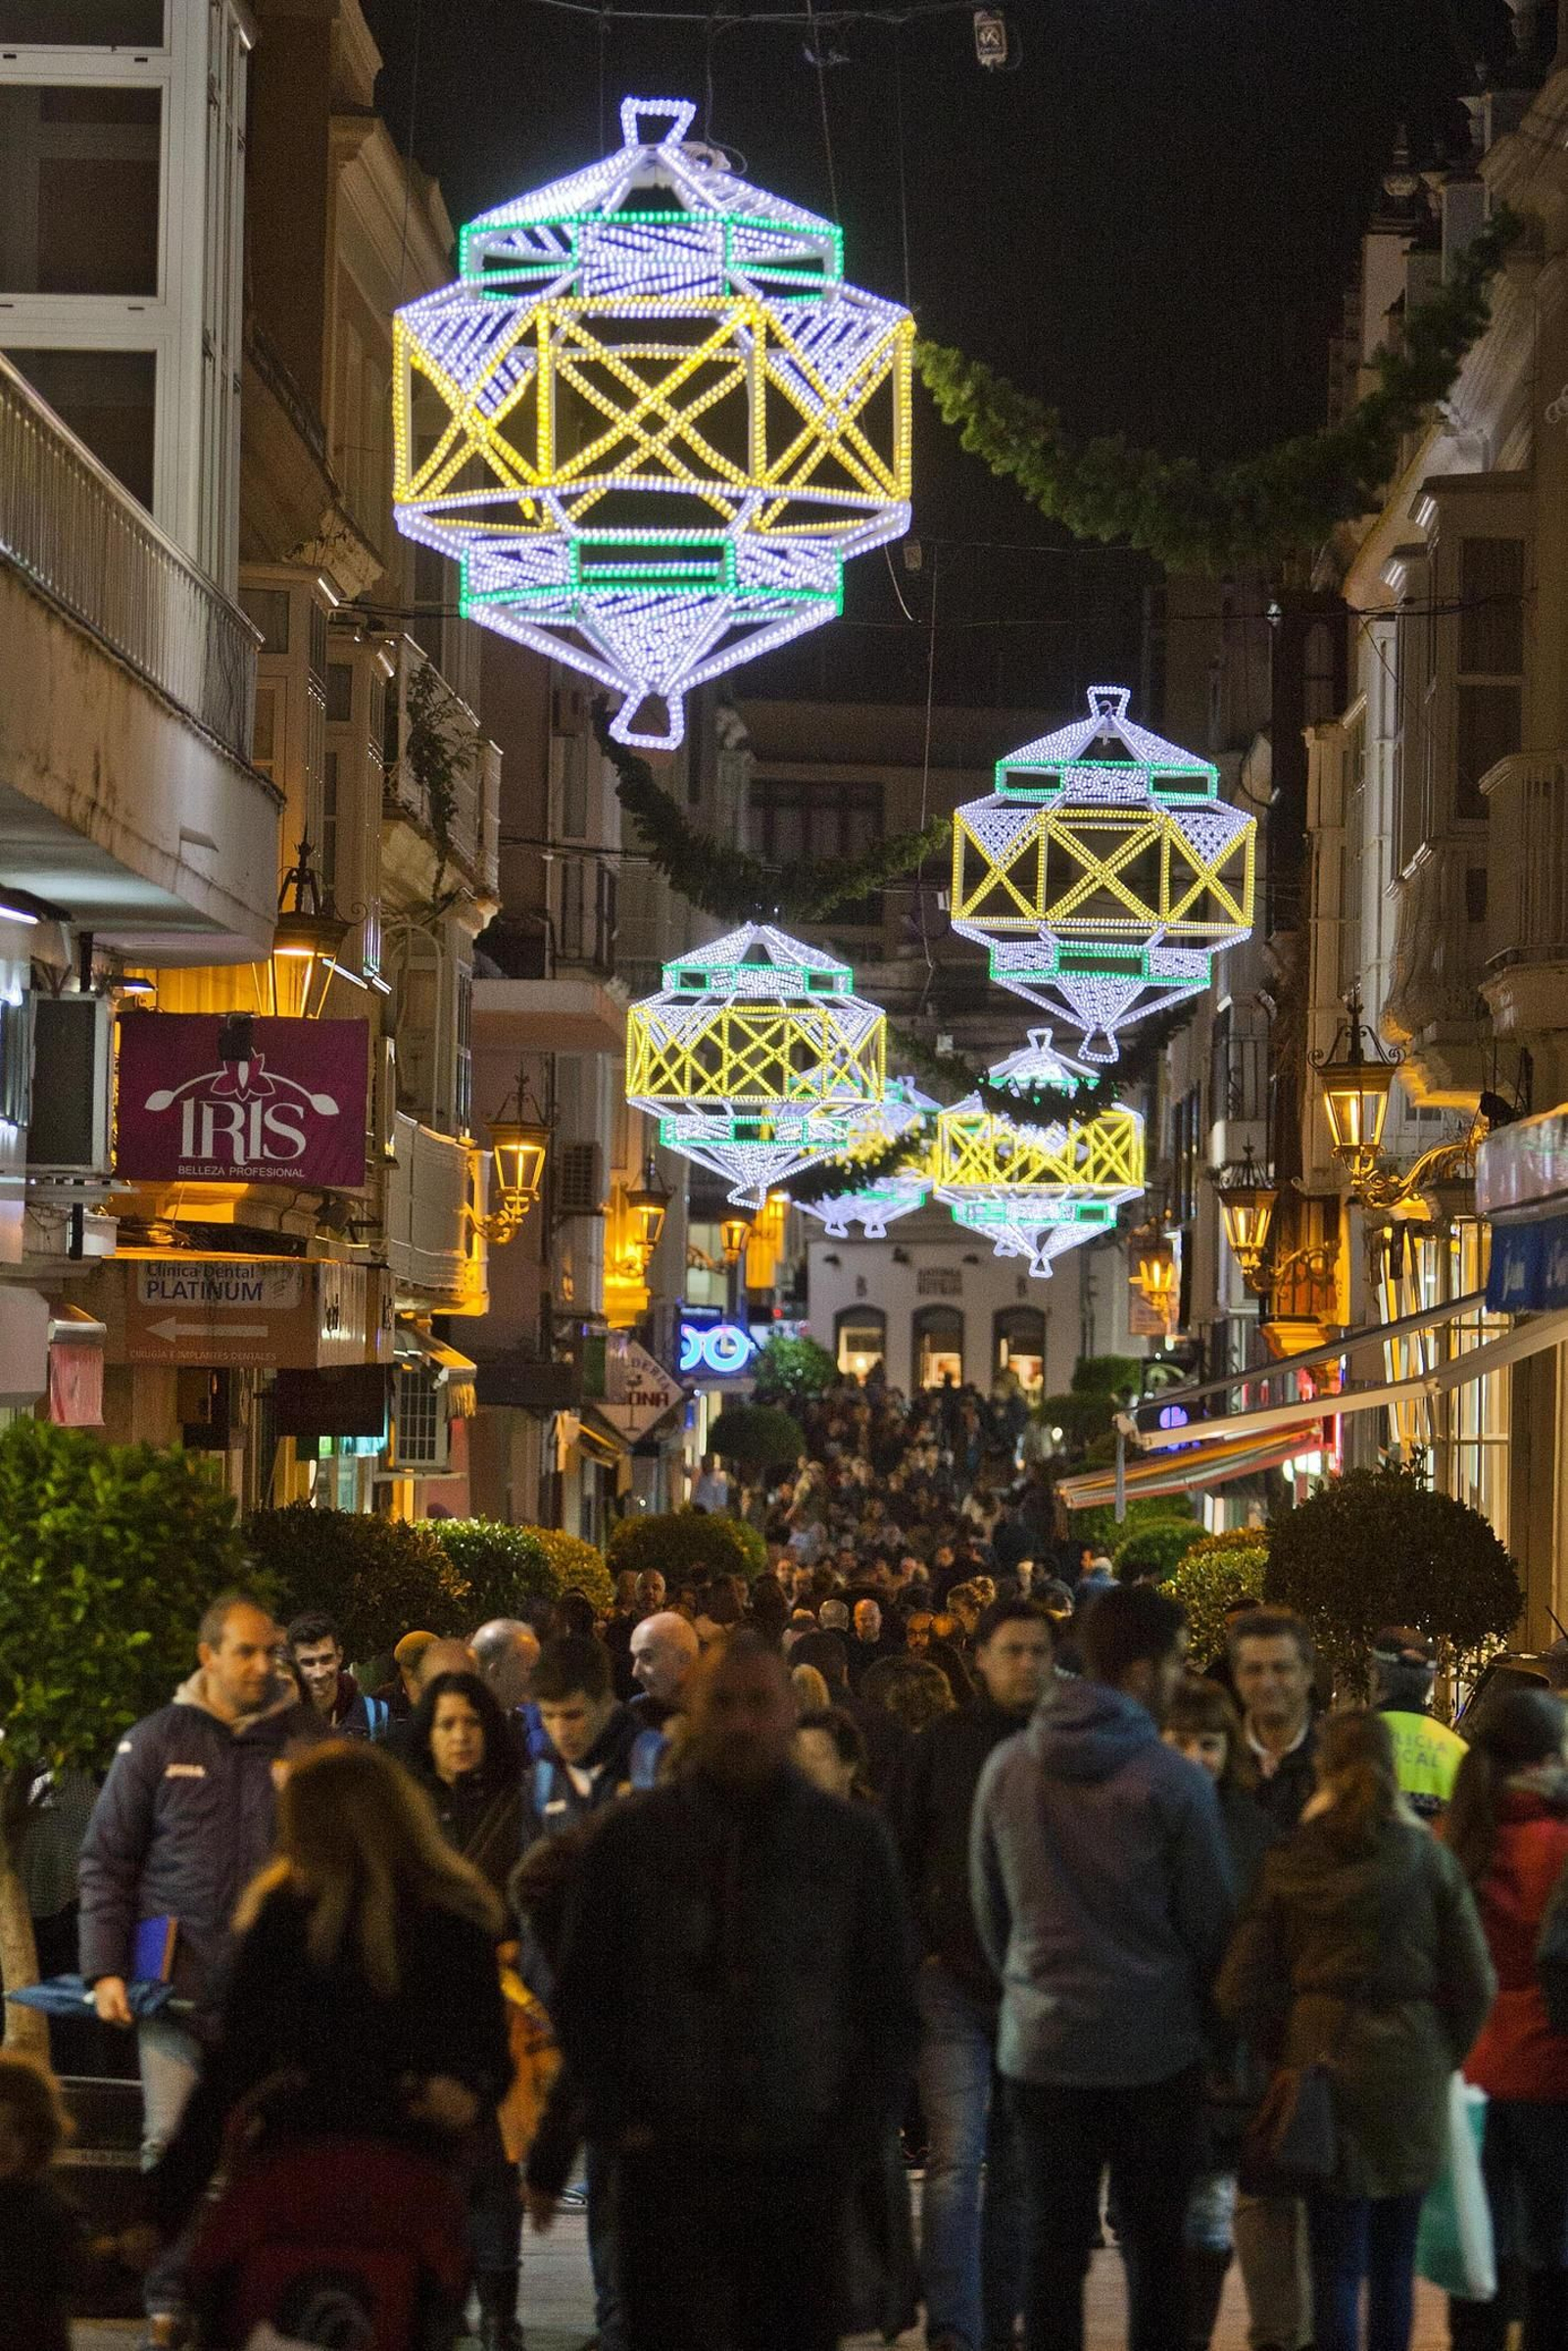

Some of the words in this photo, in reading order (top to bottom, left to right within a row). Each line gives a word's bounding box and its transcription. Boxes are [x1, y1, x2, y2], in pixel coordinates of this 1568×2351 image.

[178, 1097, 307, 1166] IRIS
[177, 1164, 225, 1176] BELLEZA
[229, 1166, 305, 1178] PROFESIONAL
[204, 1262, 255, 1279] Dental
[147, 1281, 263, 1301] PLATINUM
